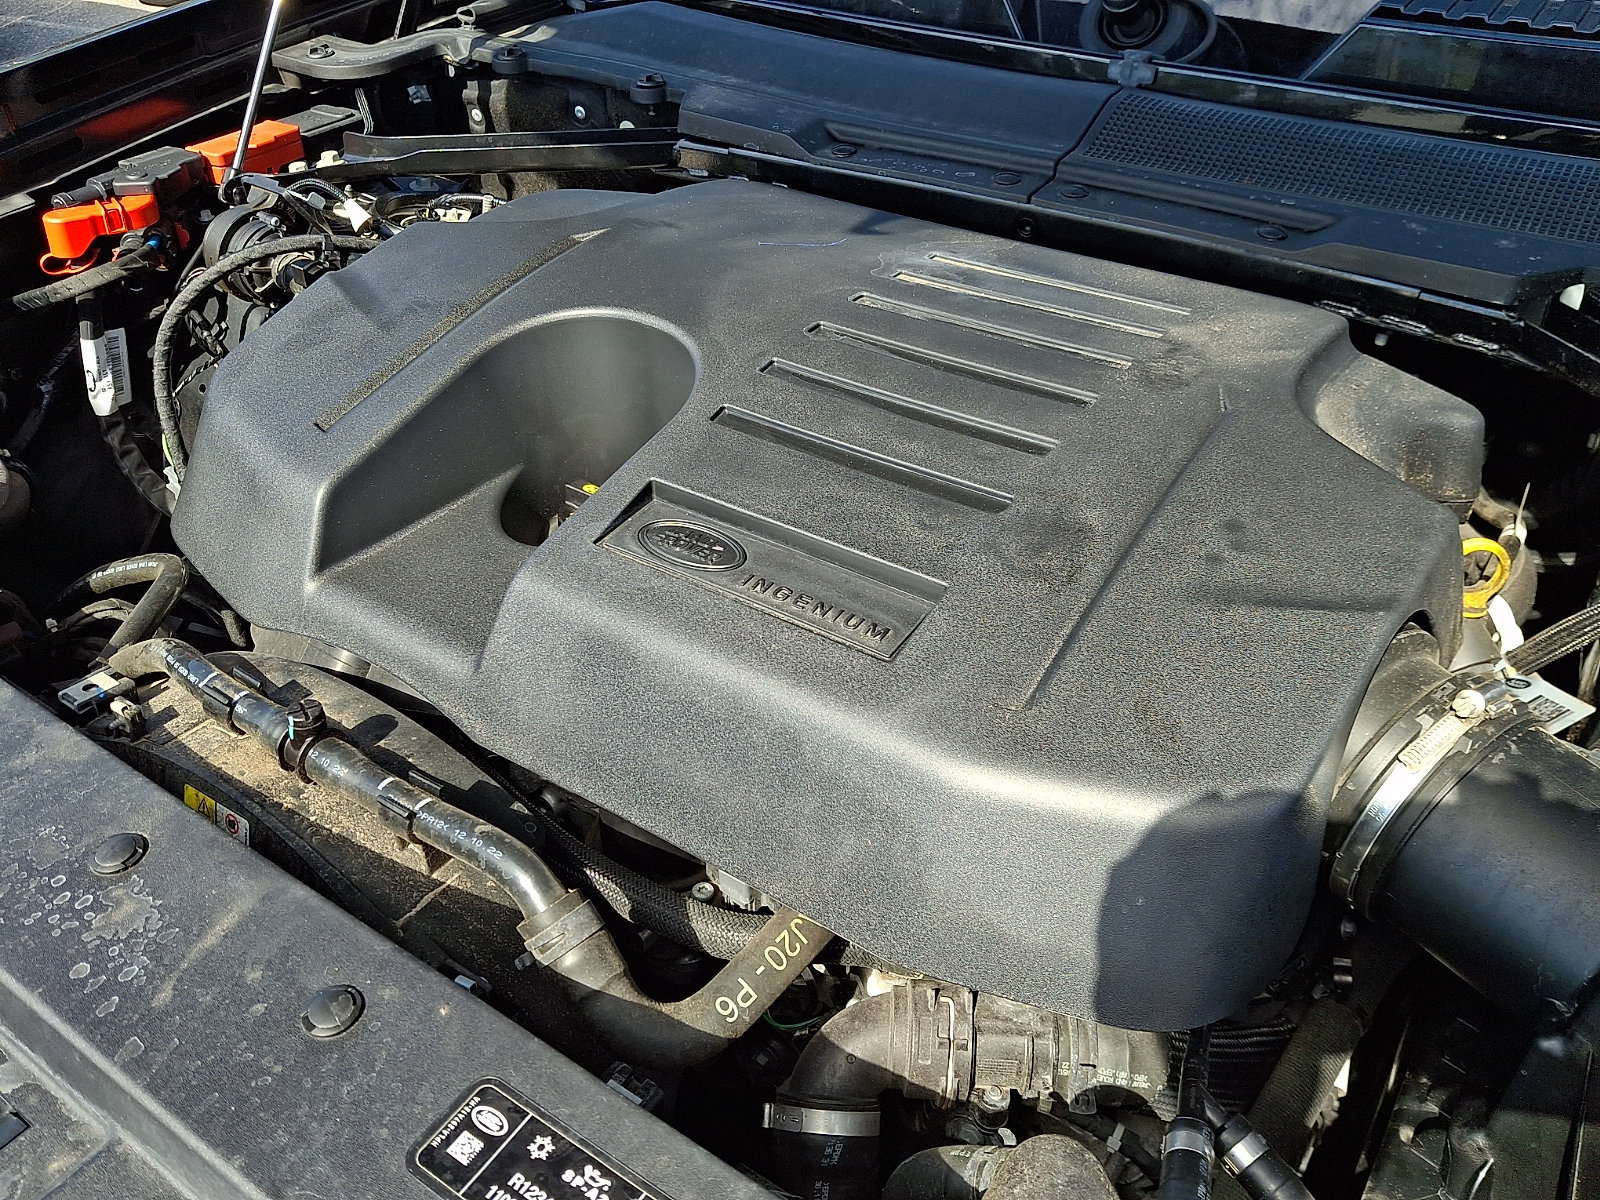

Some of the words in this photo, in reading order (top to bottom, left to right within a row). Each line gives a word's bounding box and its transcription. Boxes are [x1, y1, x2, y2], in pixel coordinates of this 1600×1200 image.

[740, 573, 893, 642] INGENIUM
[453, 829, 503, 860] 12.10.22
[714, 977, 759, 1023] P6
